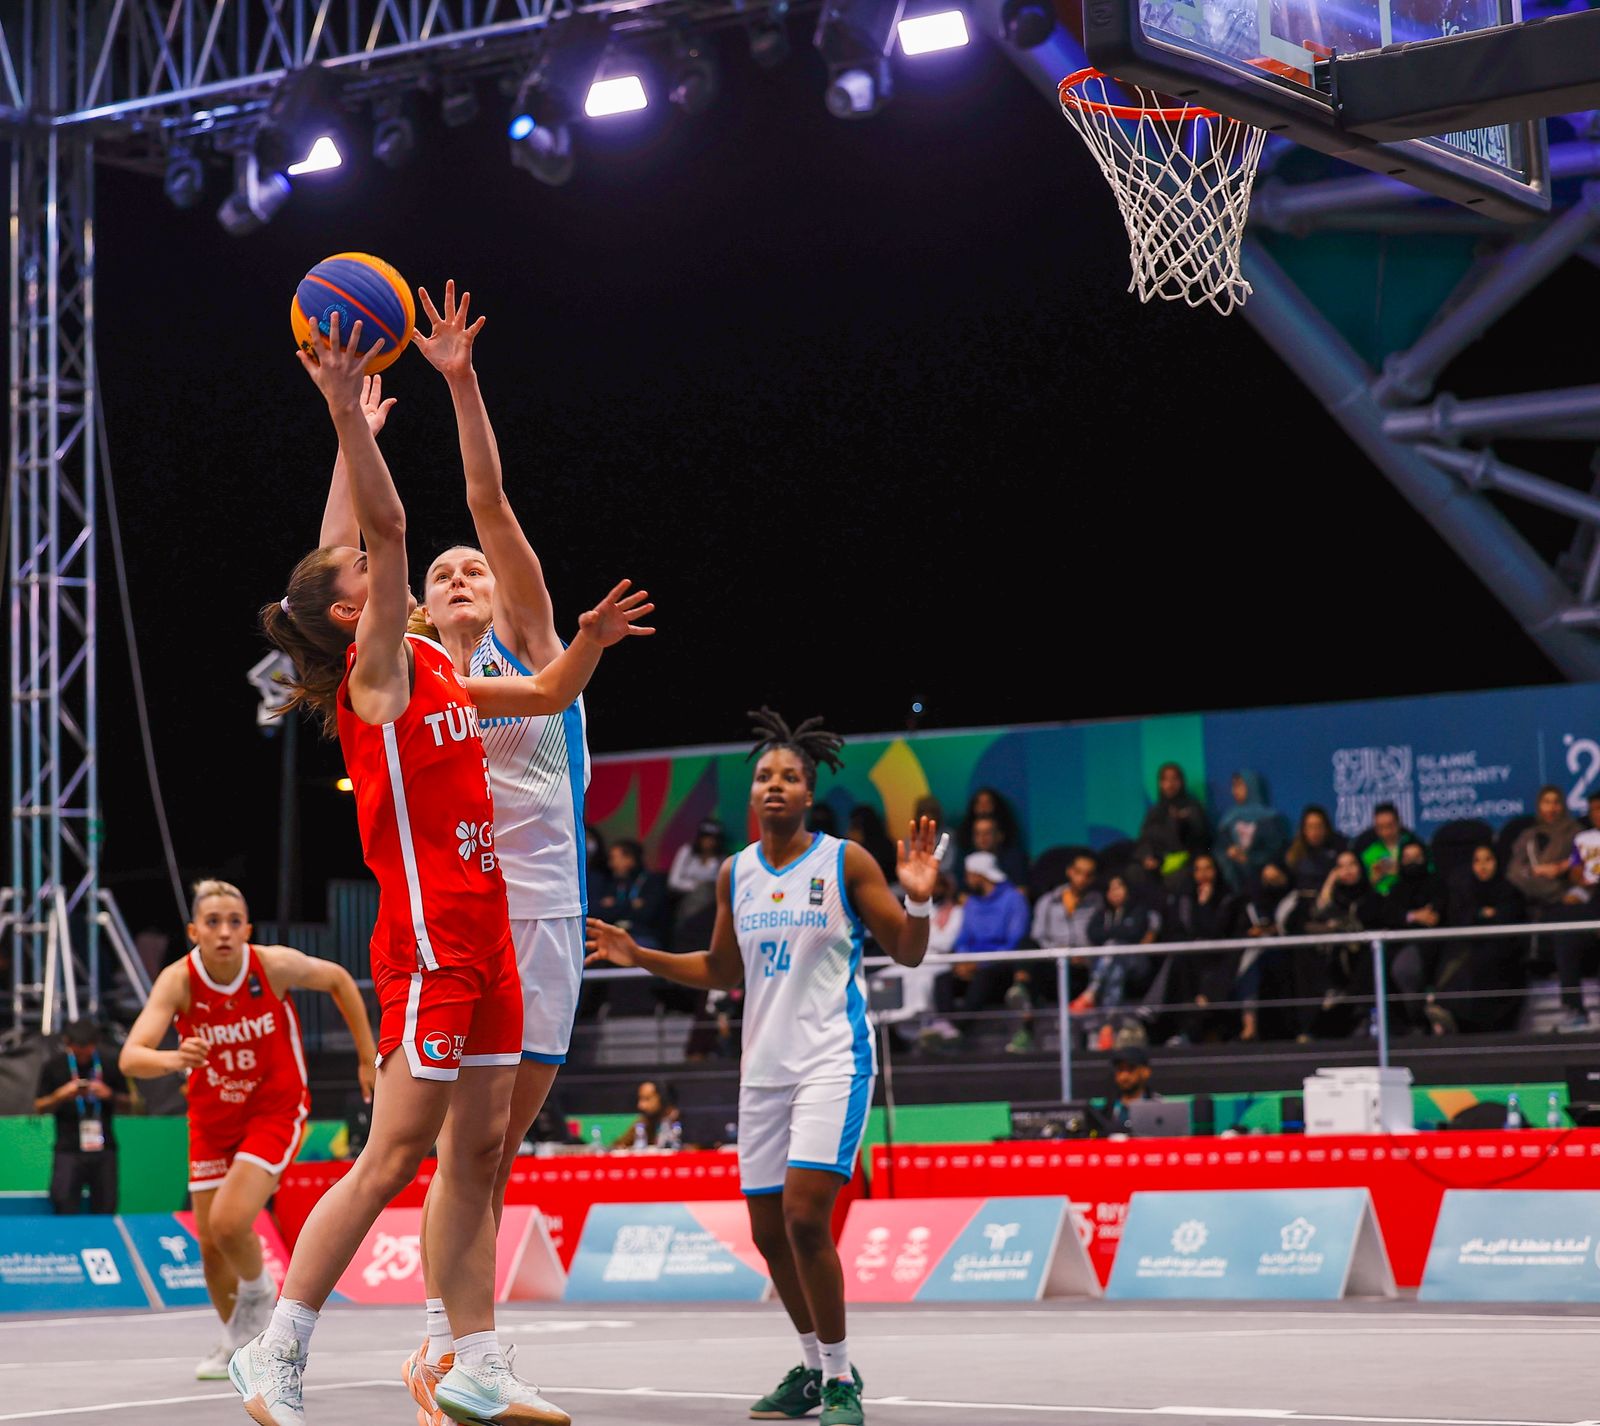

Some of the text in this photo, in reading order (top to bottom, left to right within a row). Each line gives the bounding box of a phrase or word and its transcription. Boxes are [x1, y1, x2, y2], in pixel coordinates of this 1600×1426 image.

[1417, 751, 1476, 769] ISLAMIC
[1418, 766, 1511, 786] SOLIDARITY
[1419, 786, 1476, 805] SPORTS
[1421, 799, 1524, 821] ASSOCIATION
[760, 940, 791, 977] 34
[218, 1049, 257, 1072] 18
